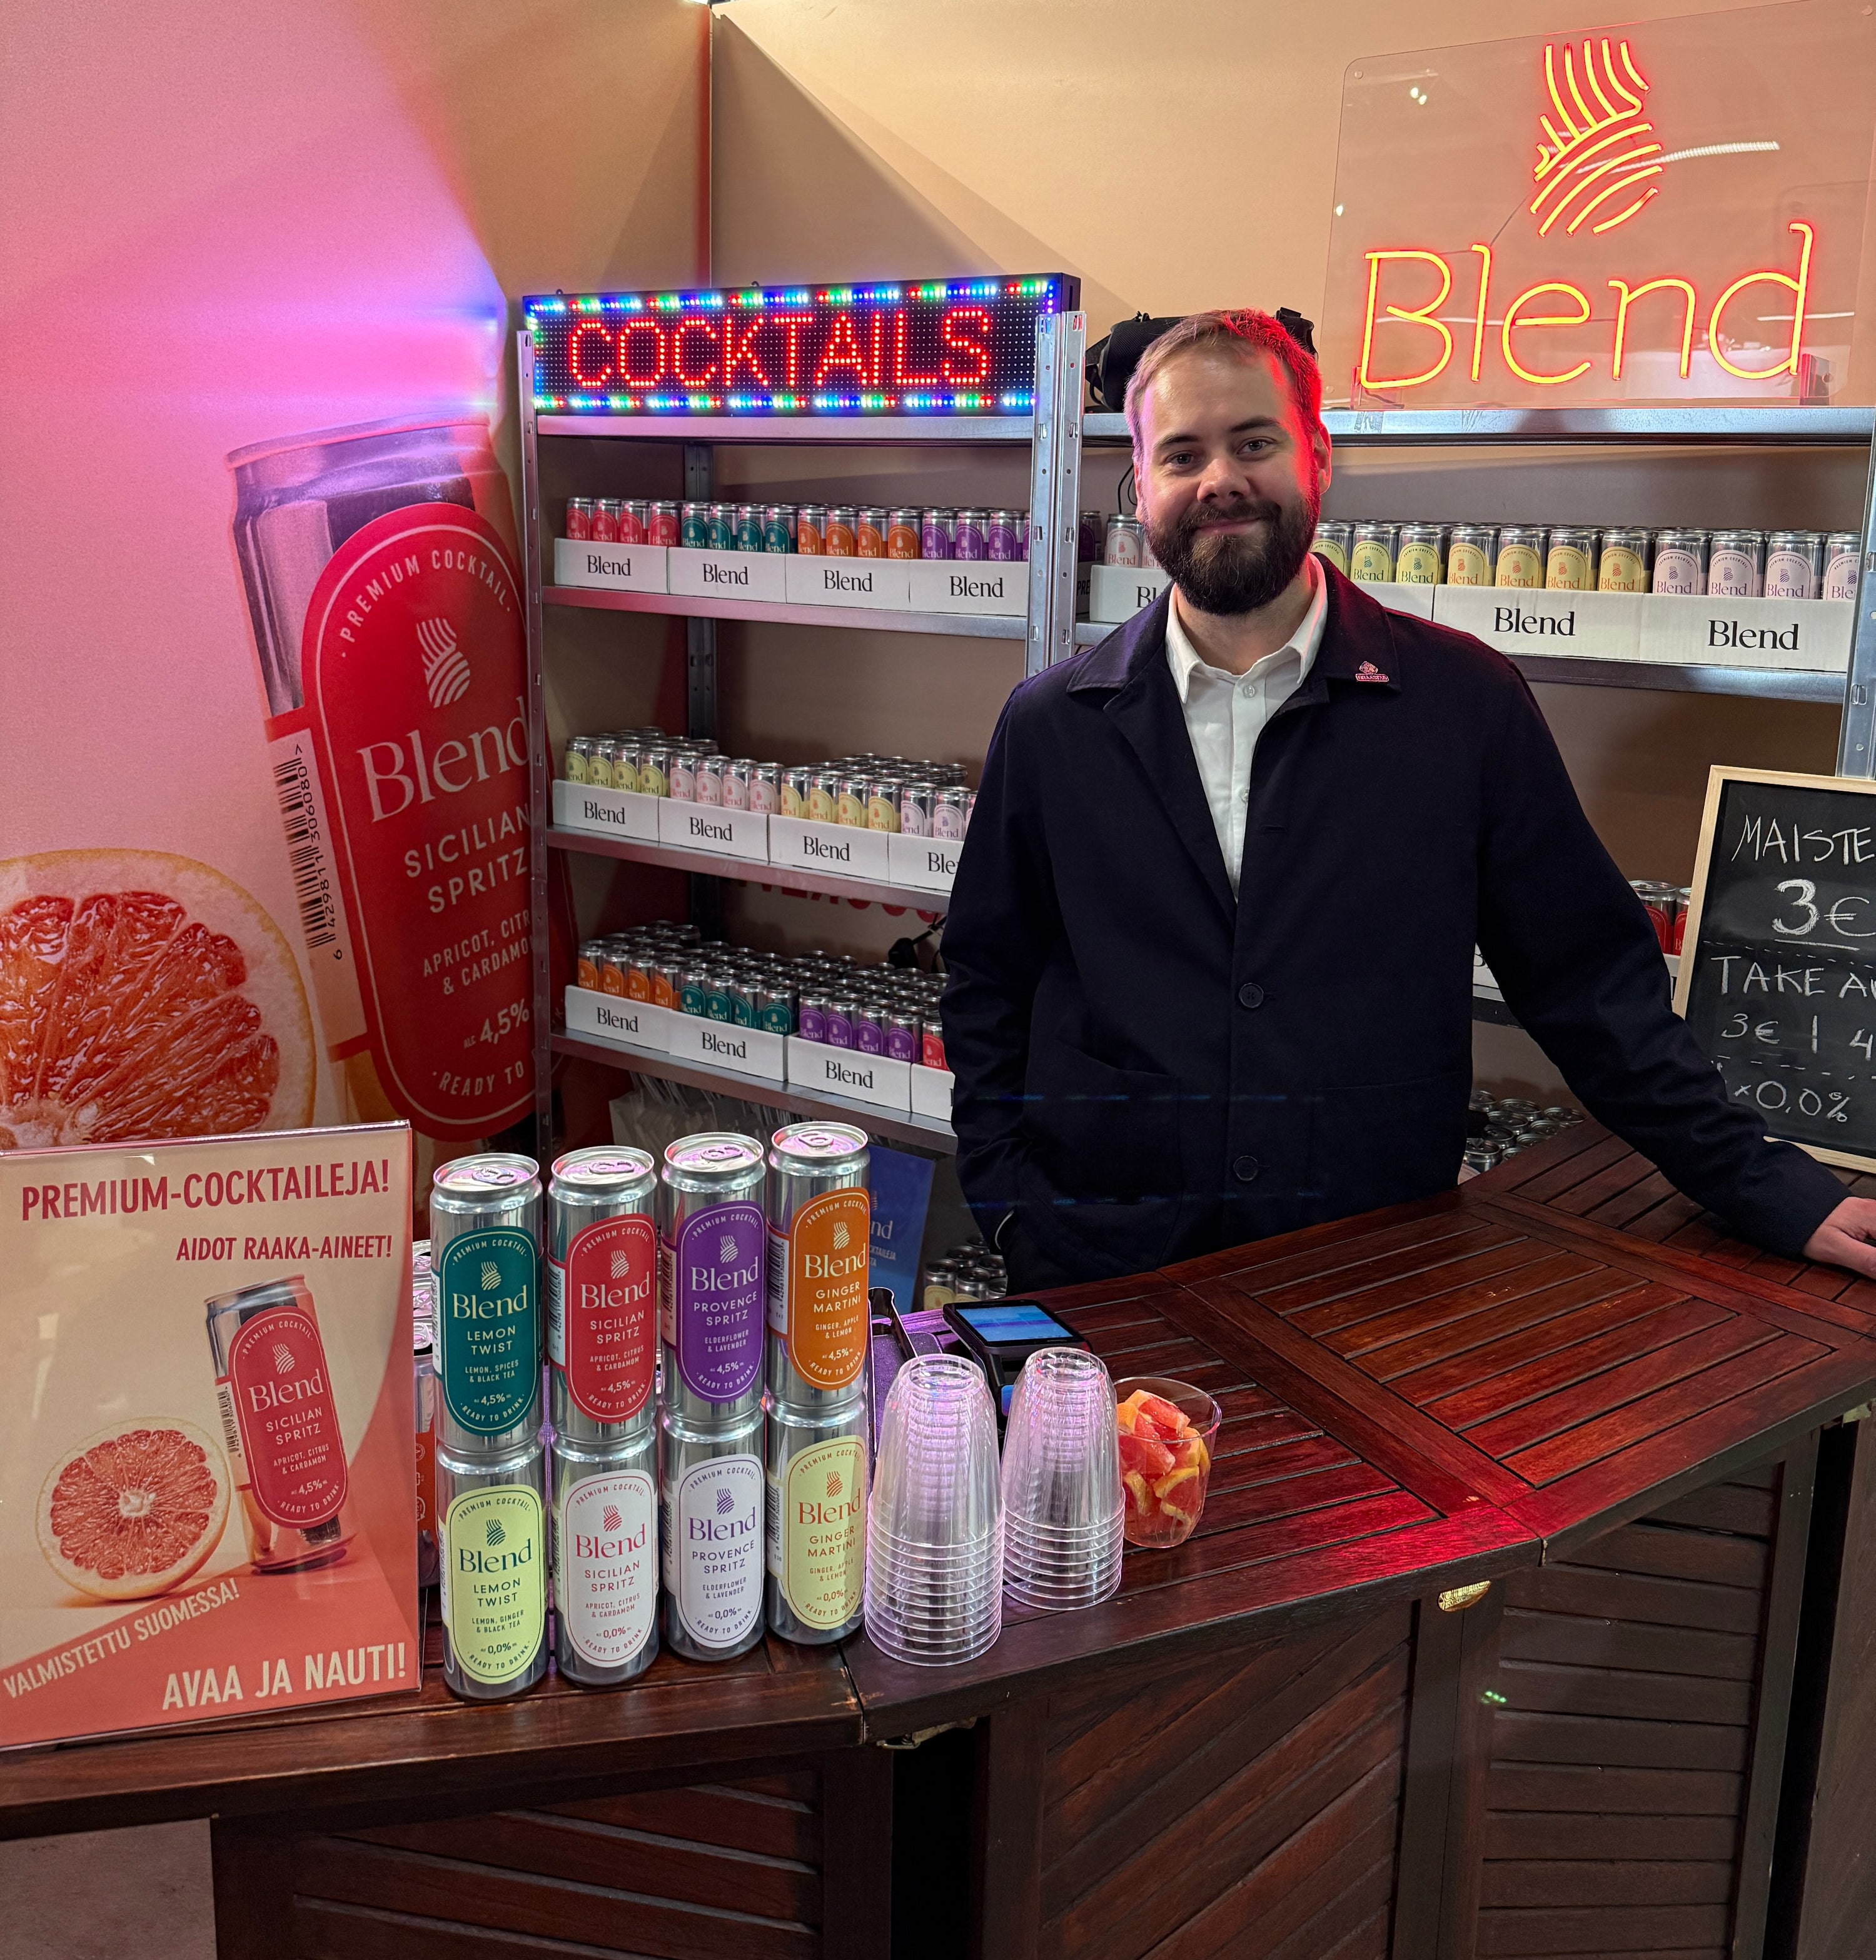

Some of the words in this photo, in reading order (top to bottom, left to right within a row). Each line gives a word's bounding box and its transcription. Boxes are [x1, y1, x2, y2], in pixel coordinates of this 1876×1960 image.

[1359, 222, 1815, 389] Blend
[568, 305, 991, 388] COCKTAILS
[587, 555, 632, 576] Blend
[1108, 553, 1136, 566] Blend
[703, 563, 749, 585] Blend
[824, 570, 873, 592] Blend
[1354, 568, 1384, 581] Blend
[1401, 570, 1434, 584] Blend
[1449, 571, 1478, 585] Blend
[1501, 575, 1534, 587] Blend
[1548, 576, 1580, 589] Blend
[1600, 578, 1634, 591] Blend
[340, 554, 421, 643] PREMIUM
[431, 549, 507, 606] COCKTAIL
[950, 576, 1004, 598] Blend
[1657, 581, 1692, 595] Blend
[1711, 583, 1747, 596] Blend
[1767, 584, 1803, 598] Blend
[1493, 607, 1576, 636] Blend
[1708, 620, 1799, 650] Blend
[356, 696, 529, 823] Blend
[297, 765, 320, 842] 306080
[584, 801, 625, 825] Blend
[403, 802, 530, 878] SICILIAN
[689, 817, 733, 842] Blend
[1731, 814, 1875, 865] MAISTE
[803, 835, 850, 862] Blend
[927, 852, 960, 874] Ble
[315, 853, 336, 927] 429811
[428, 847, 528, 913] SPRITZ
[501, 909, 530, 938] CITR
[443, 977, 454, 995] &
[461, 934, 535, 987] CARDAMO
[1711, 955, 1825, 996] TAKE
[479, 998, 530, 1045] 4,5%
[597, 1007, 638, 1033] Blend
[1721, 1013, 1780, 1044] 3€
[702, 1032, 747, 1059] Blend
[439, 1072, 495, 1095] READY
[504, 1061, 524, 1085] TO
[825, 1060, 874, 1089] Blend
[22, 1158, 390, 1221] PREMIUM-COCKTAILEJA!
[807, 1202, 839, 1225] PREMIUM
[844, 1200, 867, 1215] COCKTAIL
[693, 1216, 726, 1238] PREMIUM
[730, 1214, 758, 1229] COCKTAIL
[176, 1237, 236, 1261] AIDOT
[243, 1235, 392, 1260] RAAKA-AINEET!
[583, 1230, 617, 1254] PREMIUM
[622, 1227, 649, 1242] COCKTAIL
[453, 1240, 487, 1264] PREMIUM
[492, 1239, 526, 1256] COCKTAIL
[804, 1243, 866, 1279] Blend
[690, 1256, 759, 1292] Blend
[580, 1271, 650, 1309] Blend
[815, 1281, 860, 1300] GINGER
[453, 1285, 528, 1319] Blend
[693, 1291, 757, 1312] PROVENCE
[814, 1294, 860, 1313] MARTINI
[590, 1310, 645, 1330] SICILIAN
[706, 1310, 749, 1326] SPRITZ
[844, 1314, 859, 1327] APPLE
[243, 1323, 275, 1355] PREMIUM
[278, 1320, 312, 1339] COCKTAIL
[467, 1325, 515, 1341] LEMON
[597, 1326, 640, 1344] SPRITZ
[705, 1329, 749, 1344] ELDERFLOWER
[832, 1329, 852, 1338] LEMON
[471, 1340, 512, 1355] TWIST
[624, 1345, 644, 1358] CITRUS
[715, 1339, 747, 1352] LAVENDER
[829, 1347, 849, 1361] 4,5%
[495, 1359, 518, 1372] SPICES
[605, 1356, 639, 1370] CARDAMOM
[717, 1360, 739, 1374] 4,5%
[478, 1374, 500, 1382] BLACK
[503, 1370, 515, 1379] TEA
[607, 1379, 630, 1394] 4,5%
[248, 1369, 325, 1413] Blend
[481, 1393, 505, 1405] 4,5%
[266, 1407, 322, 1432] SICILIAN
[276, 1423, 321, 1445] SPRITZ
[308, 1444, 330, 1457] CITRUS
[290, 1455, 326, 1472] CARDAMOM
[800, 1453, 832, 1474] PREMIUM
[837, 1449, 860, 1462] COCKTAIL
[298, 1479, 323, 1495] 4,5%
[690, 1470, 722, 1490] PREMIUM
[727, 1468, 755, 1479] COCKTAIL
[280, 1501, 306, 1513] READY
[311, 1501, 320, 1511] TO
[323, 1484, 339, 1505] DRINK
[576, 1486, 608, 1505] PREMIUM
[613, 1484, 644, 1495] COCKTAIL
[459, 1500, 491, 1520] PREMIUM
[497, 1498, 529, 1510] COCKTAIL
[799, 1487, 860, 1525] Blend
[688, 1506, 756, 1541] Blend
[575, 1523, 646, 1559] Blend
[810, 1525, 855, 1544] GINGER
[459, 1538, 532, 1574] Blend
[692, 1540, 755, 1560] PROVENCE
[808, 1537, 855, 1557] MARTINI
[585, 1560, 640, 1579] SICILIAN
[704, 1558, 745, 1574] SPRITZ
[838, 1559, 854, 1570] APPLE
[474, 1577, 520, 1594] LEMON
[592, 1576, 635, 1592] SPRITZ
[703, 1577, 747, 1591] ELDERFLOWER
[827, 1570, 847, 1581] LEMON
[477, 1592, 518, 1607] TWIST
[618, 1594, 640, 1606] CITRUS
[713, 1586, 744, 1599] LAVENDER
[824, 1589, 844, 1602] 0,0%
[500, 1609, 524, 1622] GINGER
[600, 1605, 635, 1618] CARDAMOM
[715, 1607, 737, 1620] 0,0%
[484, 1625, 505, 1633] BLACK
[509, 1620, 521, 1629] TEA
[603, 1626, 626, 1639] 0,0%
[2, 1627, 132, 1699] VALMISTETTU
[133, 1577, 241, 1642] SUOMESSA!
[488, 1642, 512, 1655] 0,0%
[162, 1665, 243, 1710] AVAA
[255, 1658, 293, 1699] JA
[305, 1642, 406, 1691] NAUTI!
